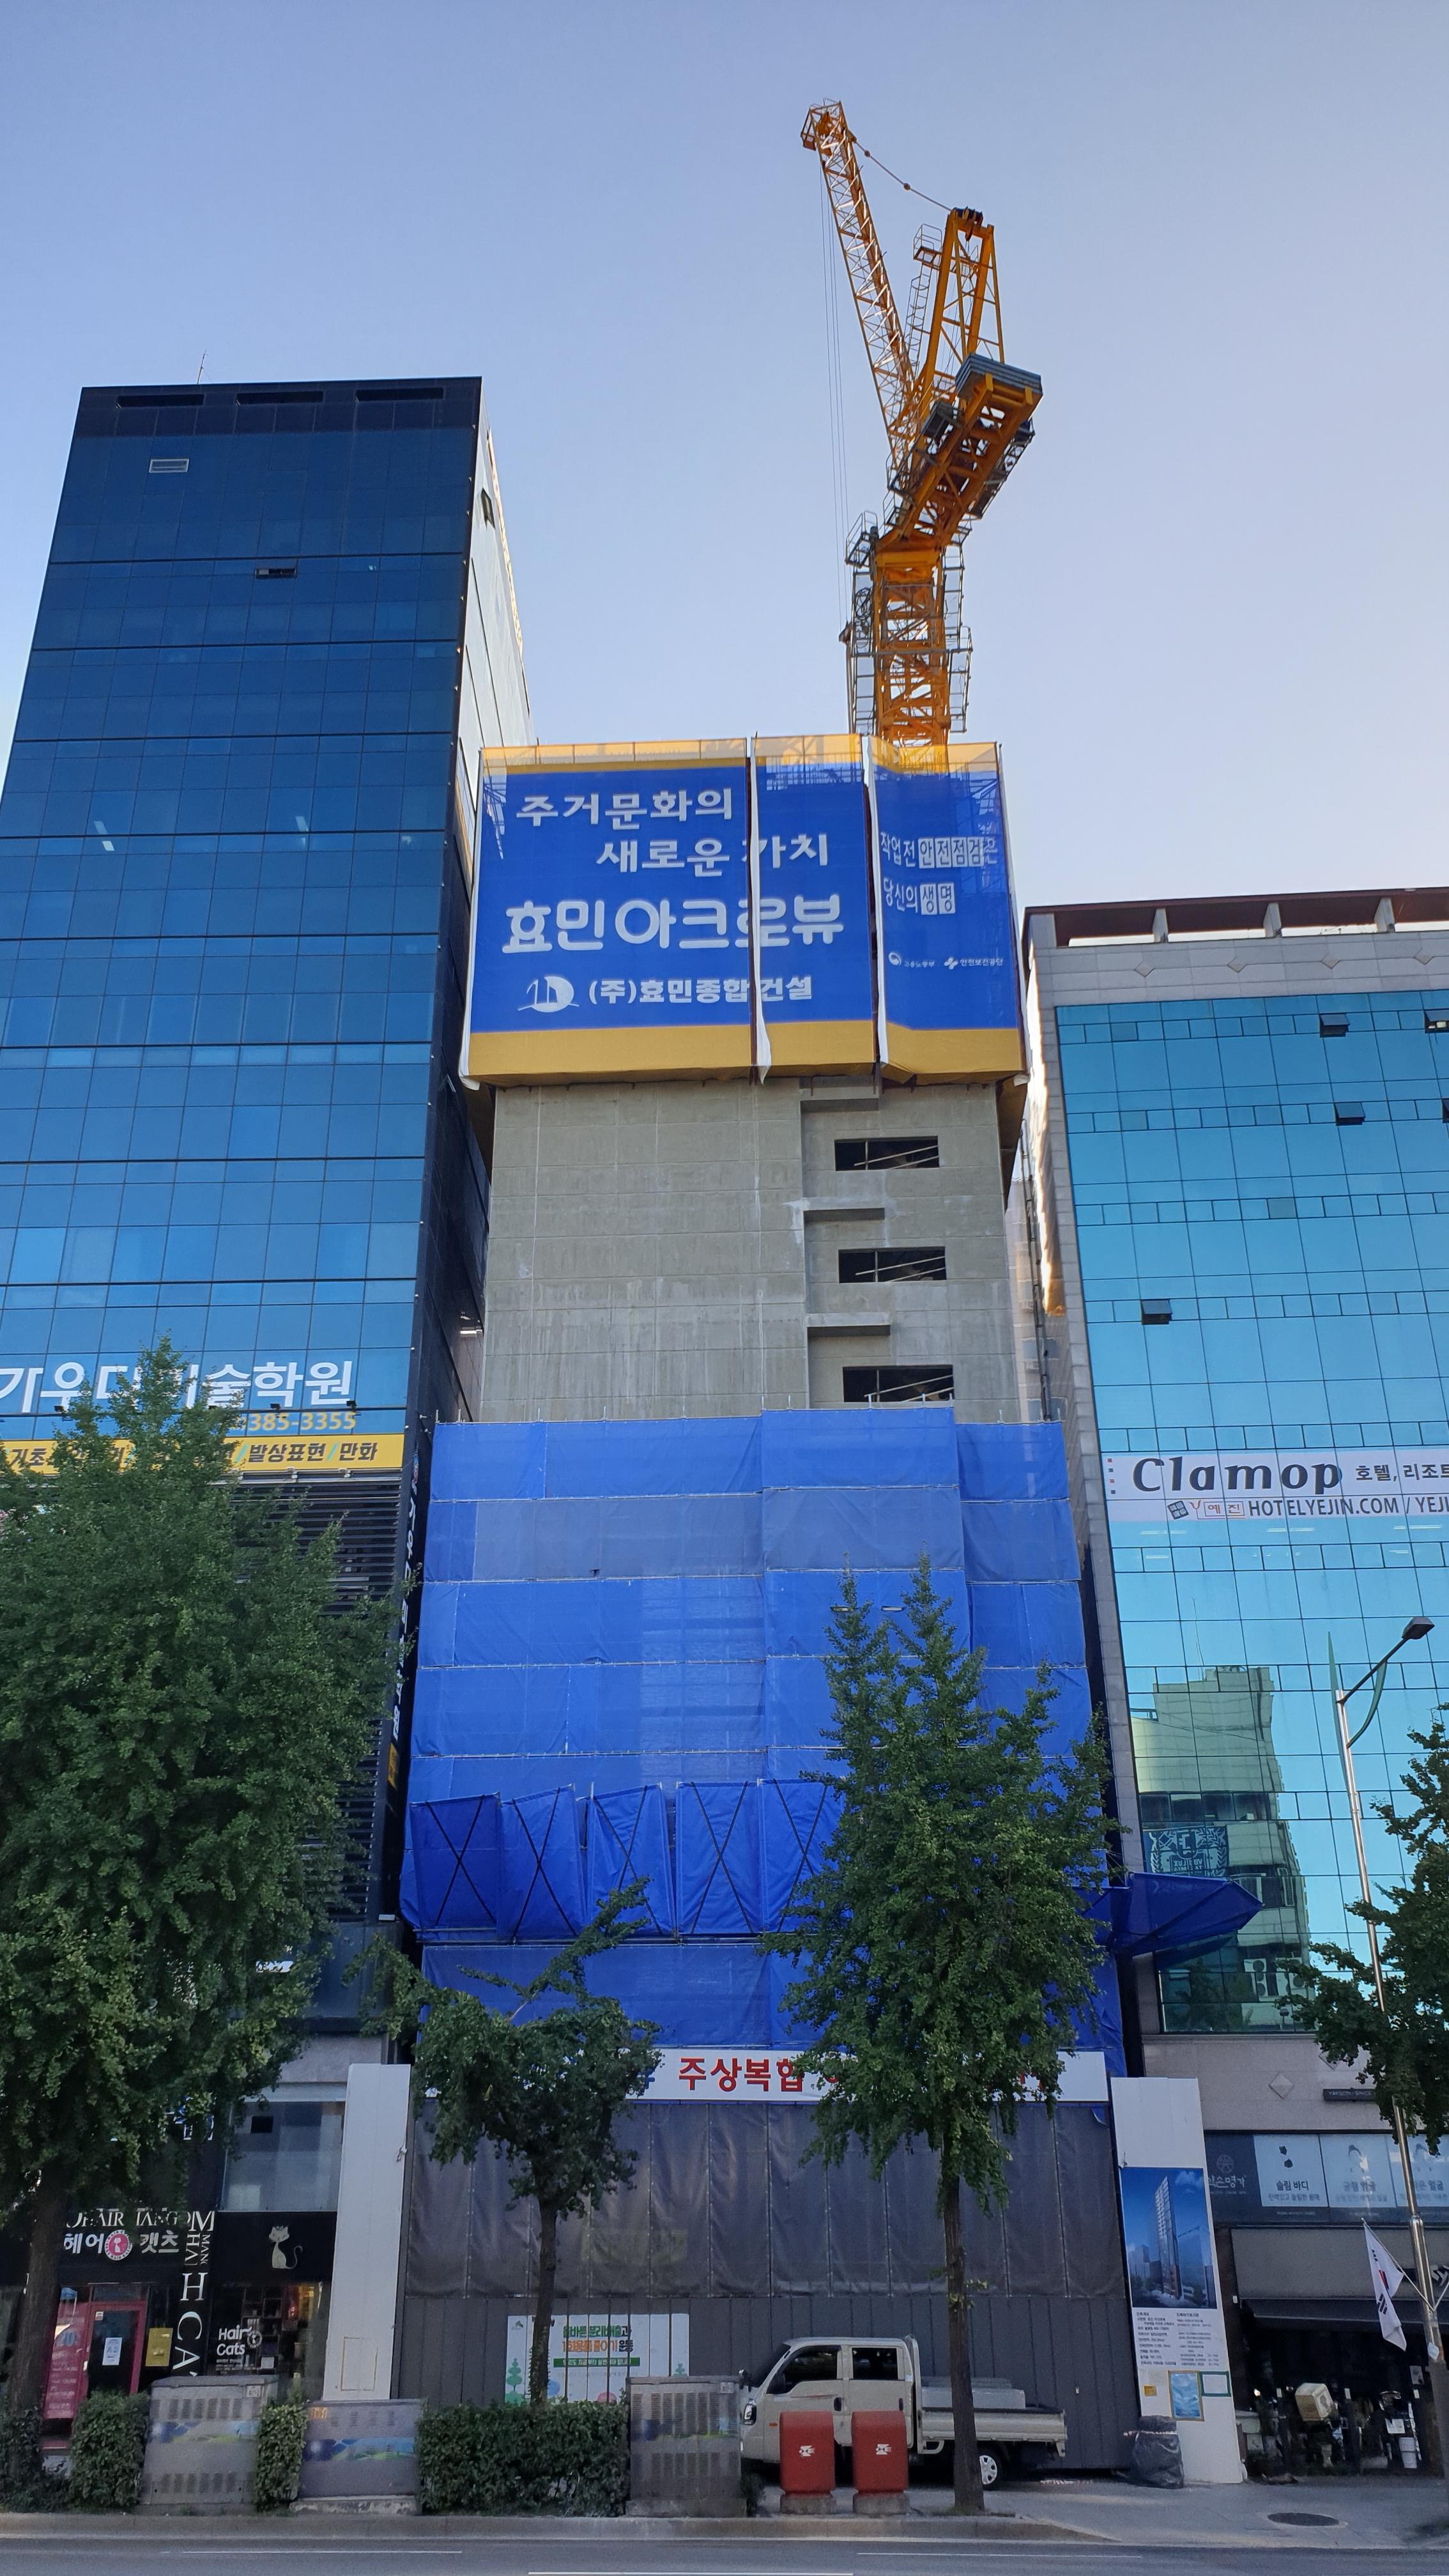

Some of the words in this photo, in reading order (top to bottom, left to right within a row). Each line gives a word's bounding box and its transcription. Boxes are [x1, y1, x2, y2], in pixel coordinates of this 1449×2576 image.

[516, 787, 733, 830] 주거문화의
[596, 838, 731, 877] 새로운
[880, 831, 916, 868] 작업전
[883, 877, 918, 914] 당신의
[920, 882, 955, 915] 생명
[248, 1442, 326, 1462] 발상표현
[339, 1442, 378, 1462] 만화
[1131, 1456, 1342, 1494] Clamop
[1248, 1497, 1399, 1517] HOTELYEJIN.COM
[217, 2342, 246, 2356] Cats
[218, 2324, 252, 2340] Hair
